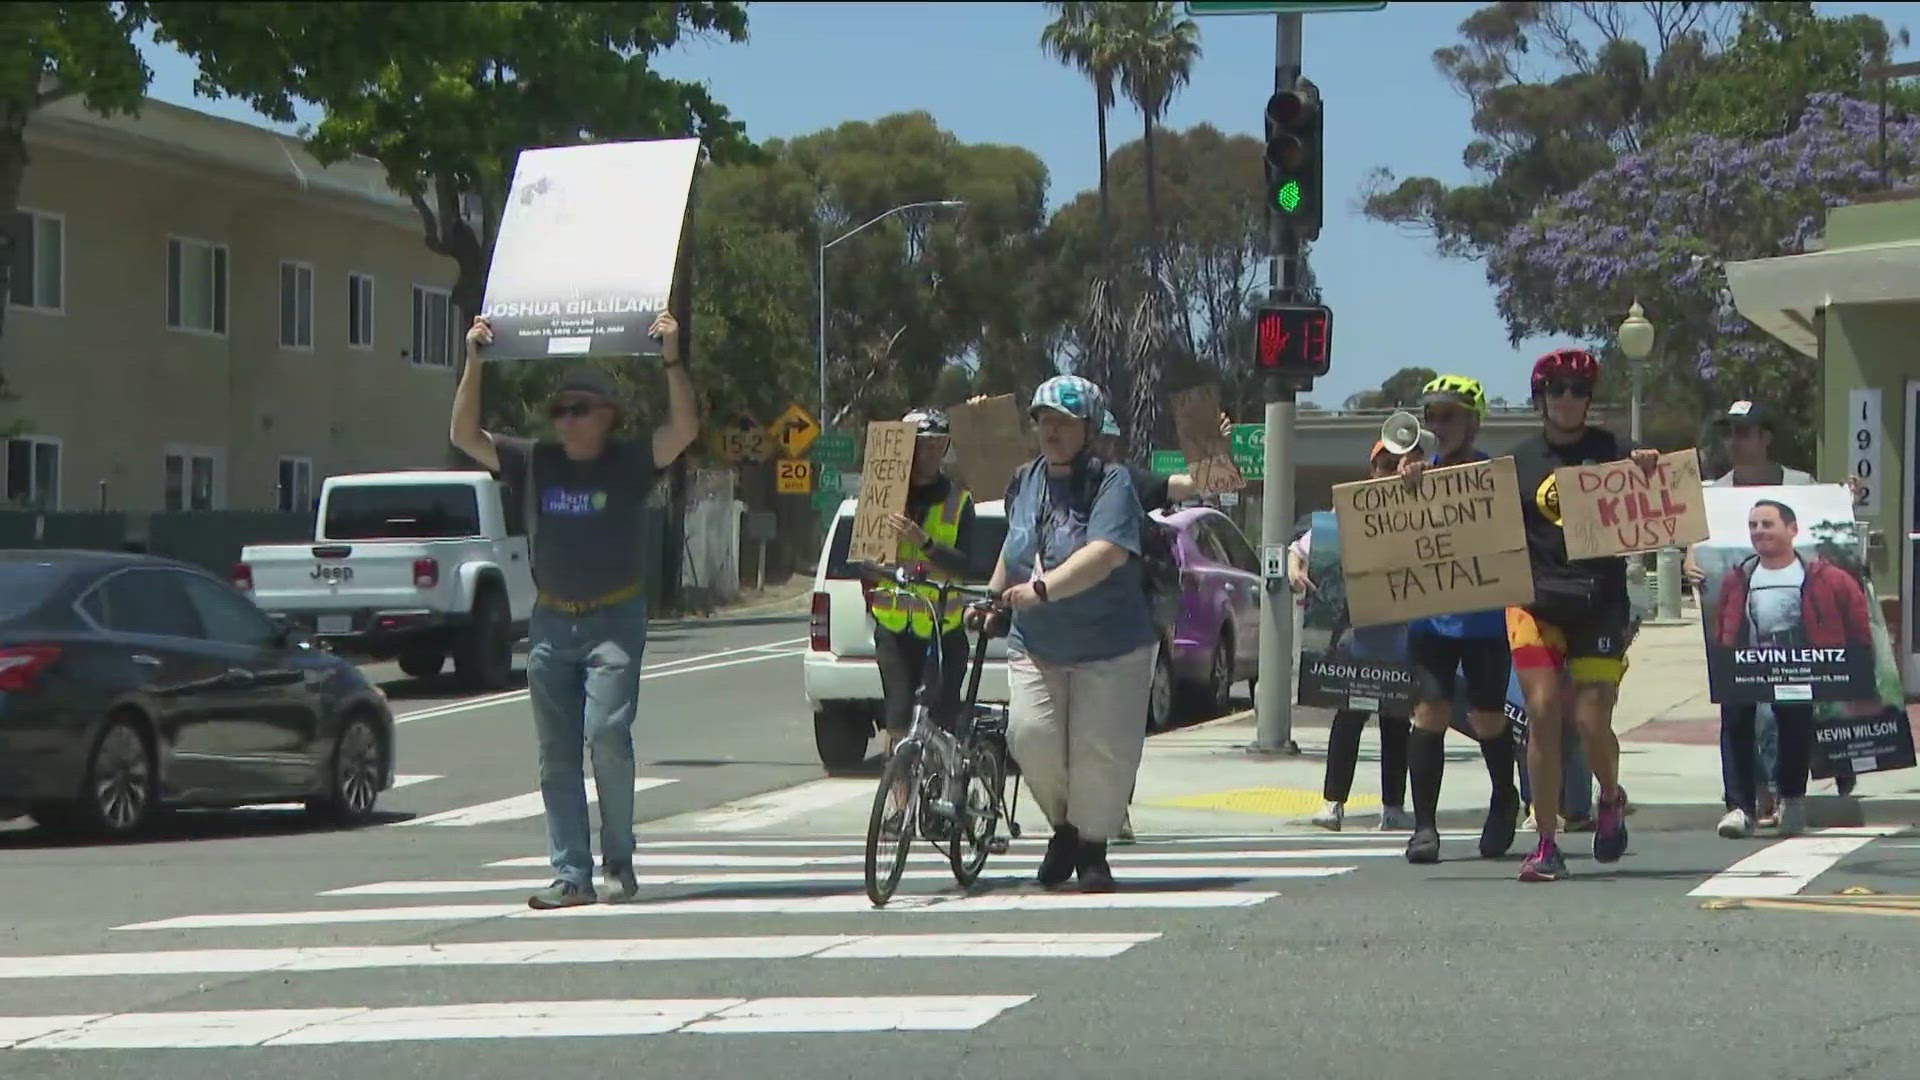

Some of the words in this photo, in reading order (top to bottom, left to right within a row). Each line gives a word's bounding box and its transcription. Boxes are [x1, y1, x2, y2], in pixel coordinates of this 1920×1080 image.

[483, 301, 560, 318] JOSHUA
[566, 296, 667, 315] GILLILAND
[1303, 318, 1328, 363] 13
[1856, 400, 1872, 506] 1902
[781, 464, 807, 479] 20
[1353, 467, 1495, 512] COMMUTING
[1364, 497, 1494, 538] SHOULDN'T
[1597, 489, 1687, 528] KILL
[1415, 533, 1454, 561] BE
[310, 564, 353, 581] Jeep
[1386, 556, 1500, 603] FATAL
[1735, 649, 1787, 664] KEVIN
[1791, 649, 1846, 663] LENTZ
[1310, 663, 1357, 679] JASON
[1360, 667, 1411, 684] GORDO
[1816, 727, 1852, 743] KEVIN
[1853, 721, 1898, 740] WILSON
